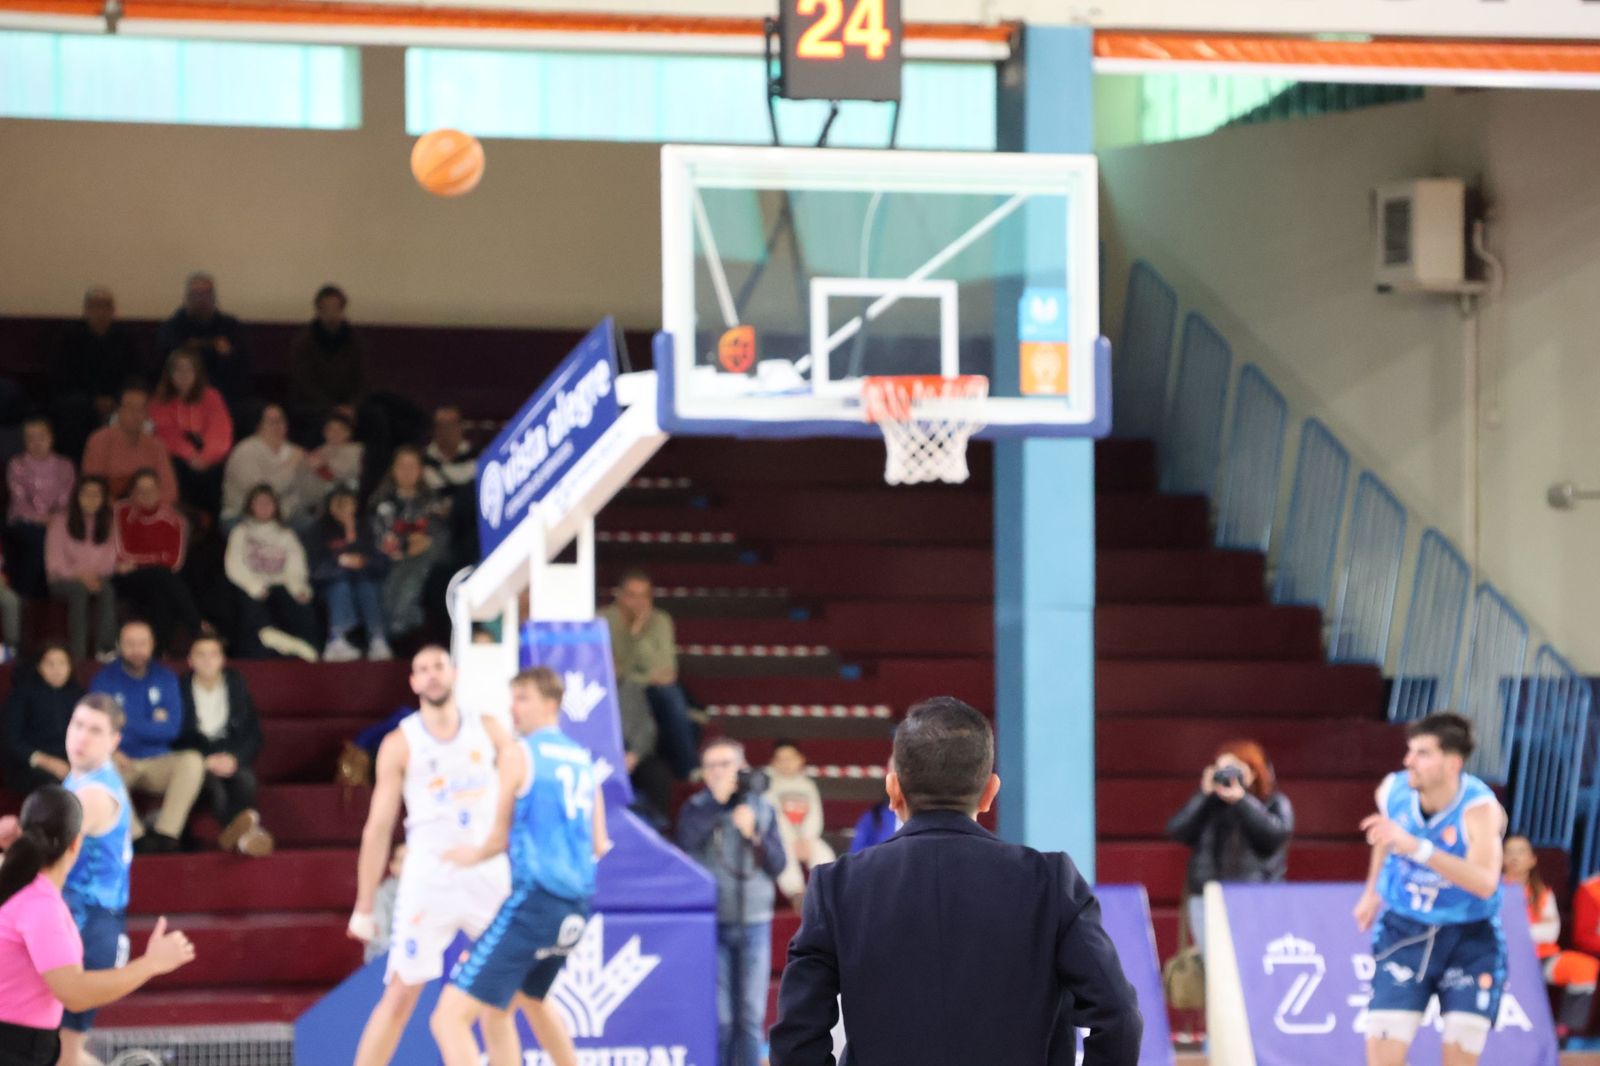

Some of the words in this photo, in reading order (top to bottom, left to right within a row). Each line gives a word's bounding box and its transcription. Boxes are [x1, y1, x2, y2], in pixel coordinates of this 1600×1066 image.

[796, 0, 892, 60] 24
[502, 425, 549, 494] vista
[547, 359, 611, 447] alegre
[555, 764, 594, 820] 14
[1405, 882, 1440, 913] 17
